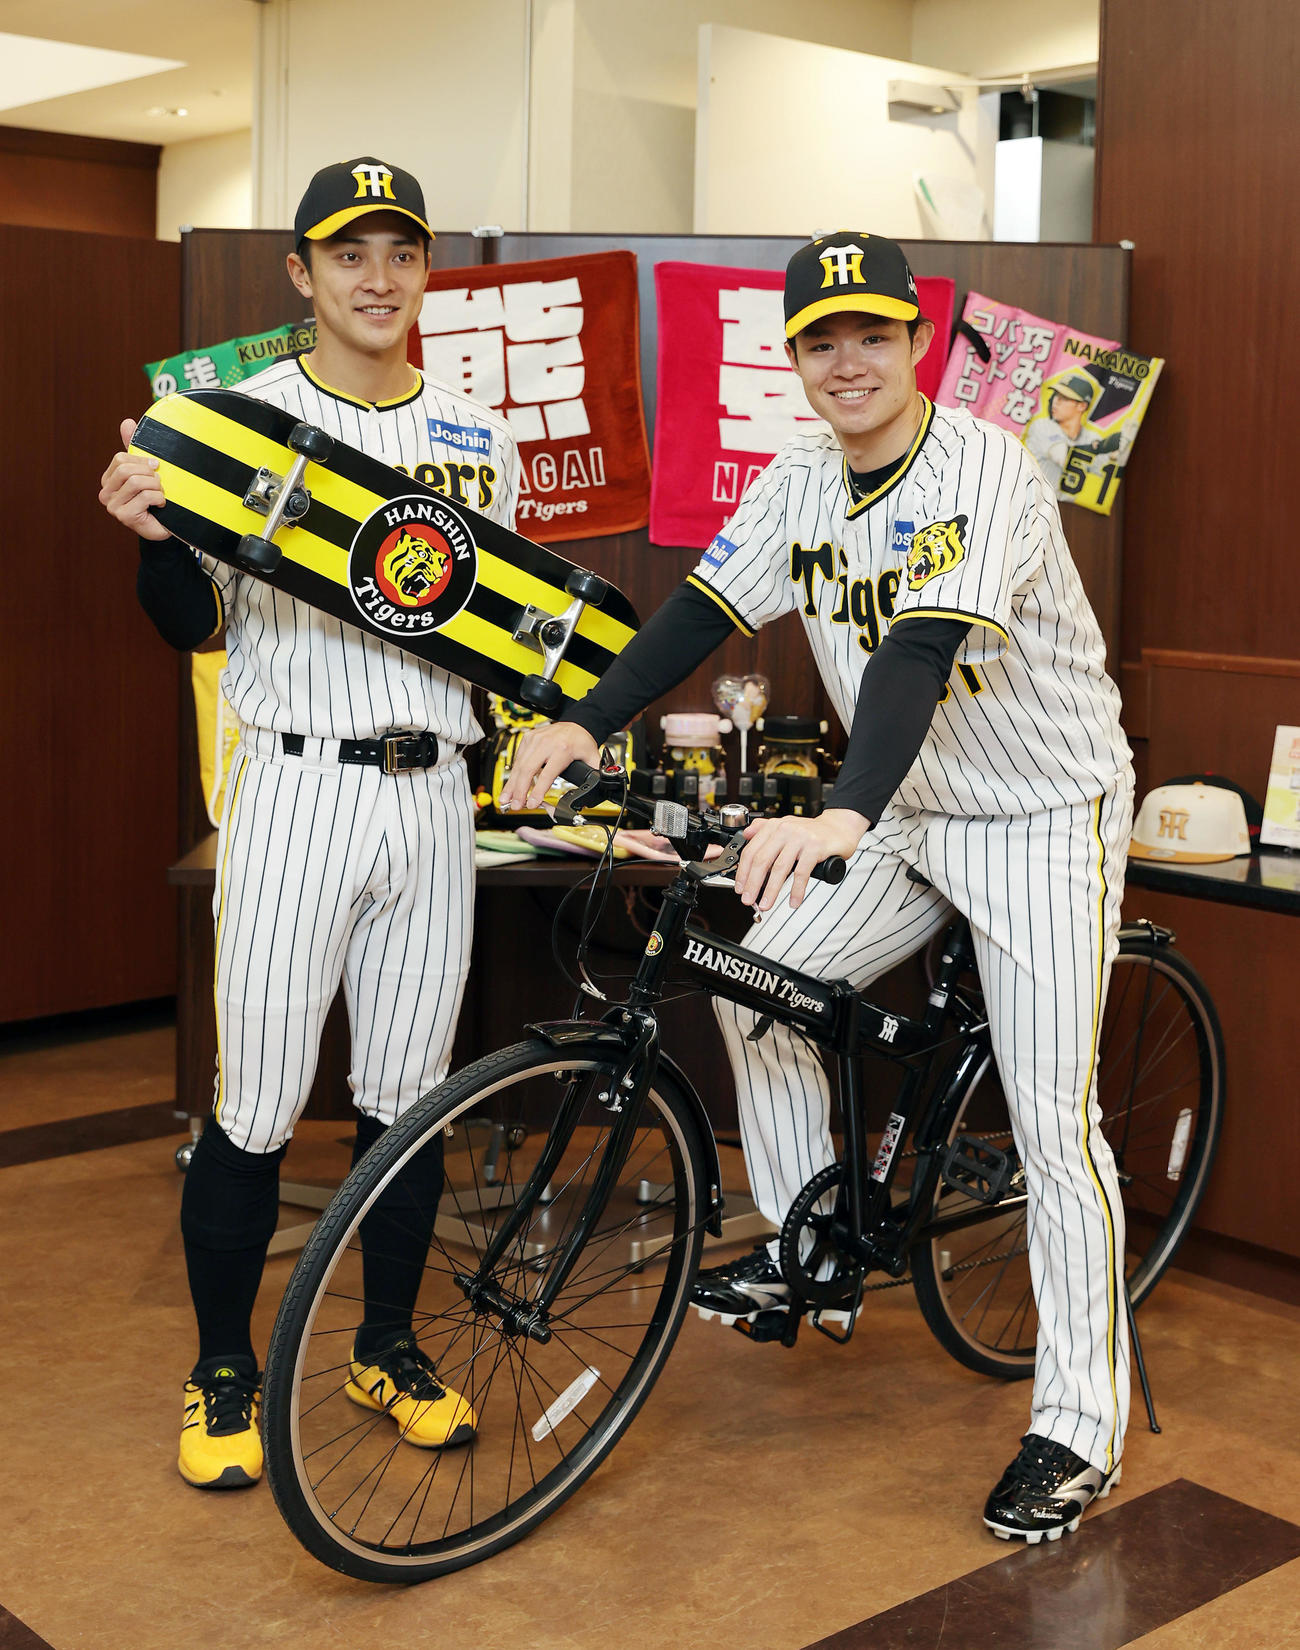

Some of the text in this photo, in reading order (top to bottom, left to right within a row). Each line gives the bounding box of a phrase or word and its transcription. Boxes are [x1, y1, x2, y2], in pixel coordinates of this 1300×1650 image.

[1063, 337, 1151, 380] NAKANO
[430, 422, 490, 450] Joshin
[1060, 449, 1117, 505] 51
[384, 503, 470, 561] HANSHIN
[518, 499, 588, 521] Tigers
[355, 576, 434, 628] Tigers
[790, 542, 903, 656] Tige
[682, 939, 780, 995] HANSHIN
[777, 978, 825, 1014] Tigers
